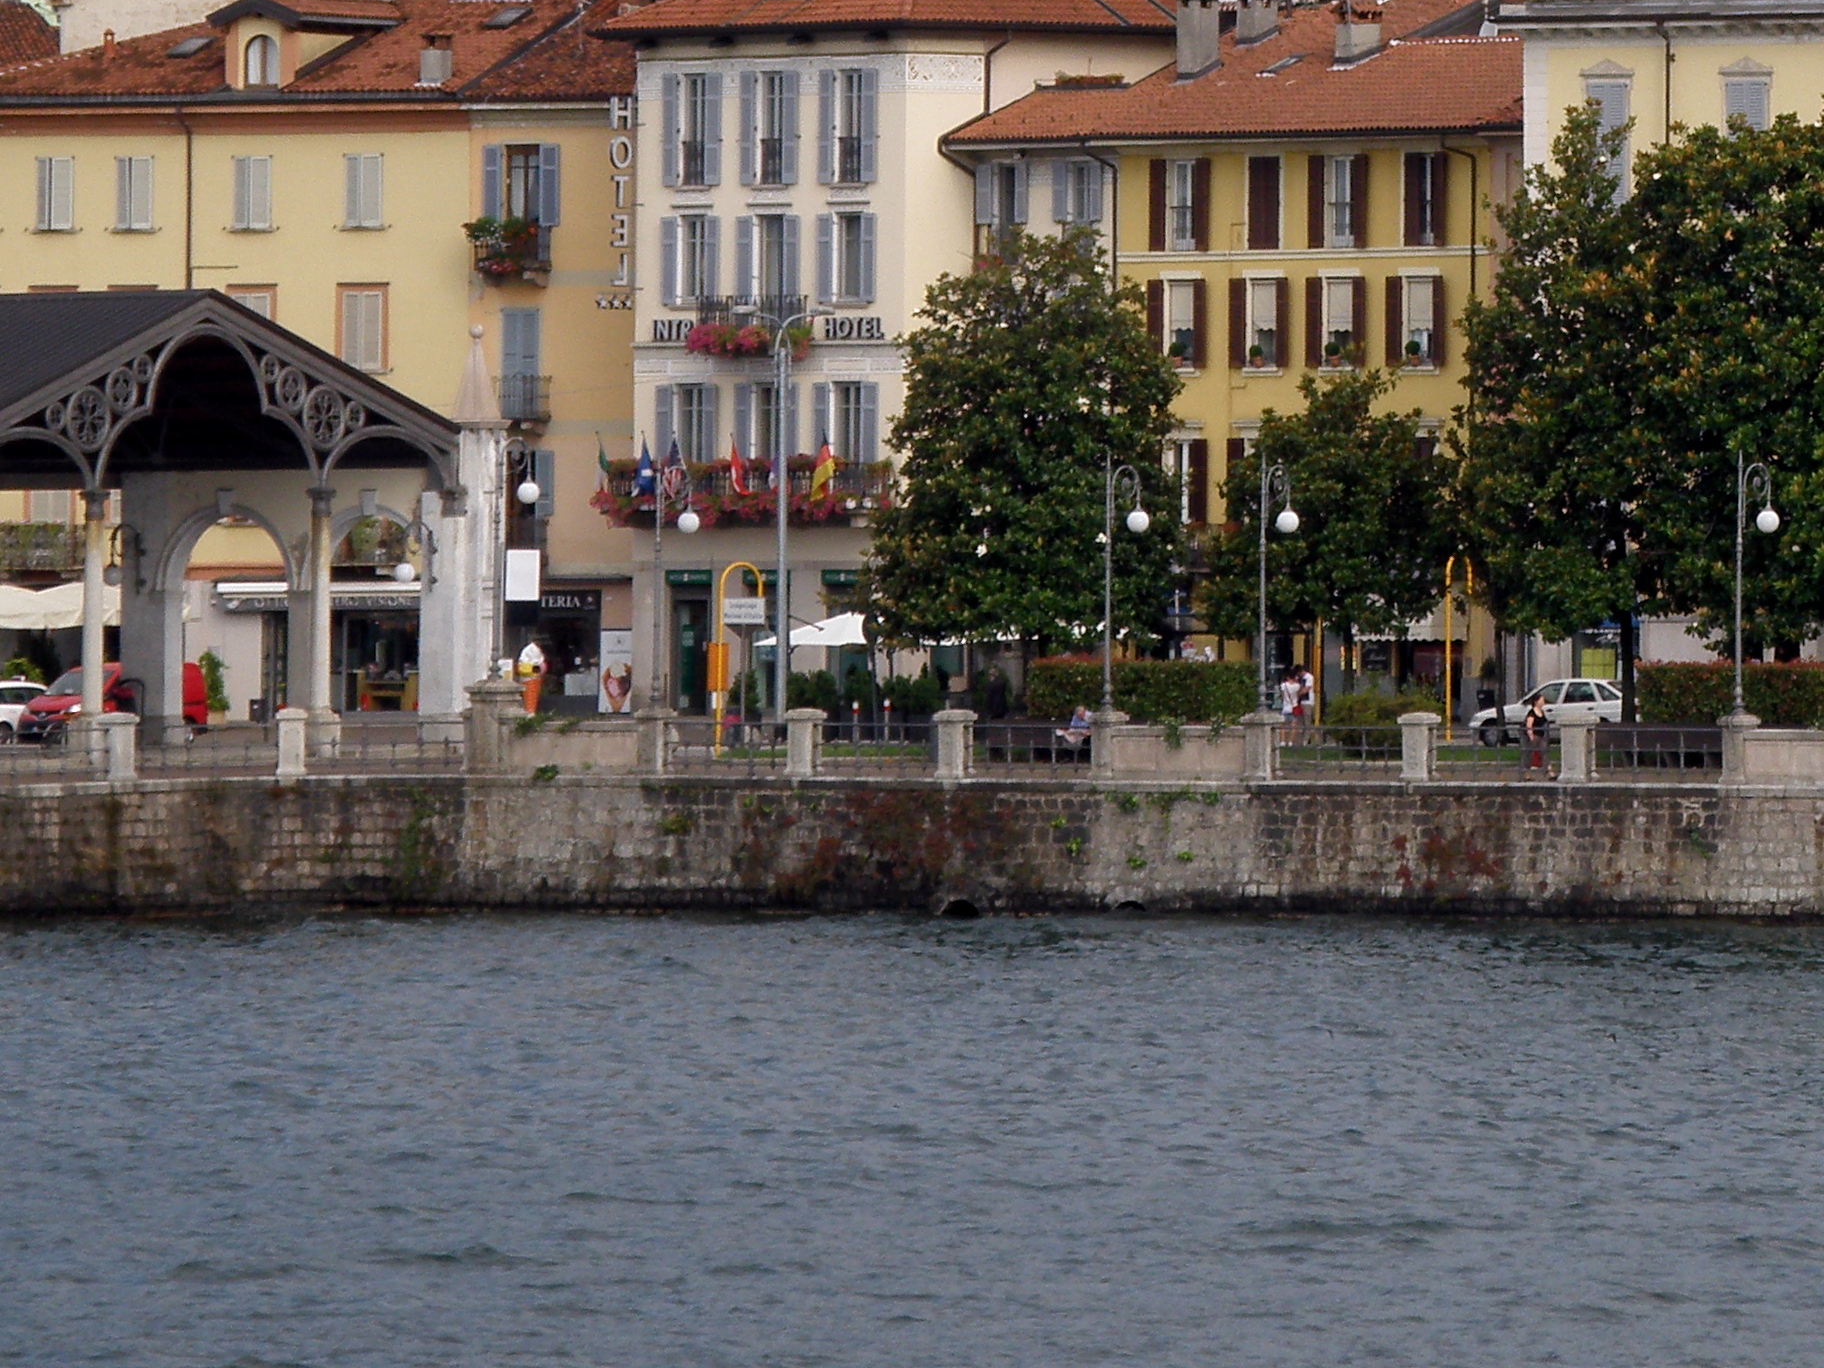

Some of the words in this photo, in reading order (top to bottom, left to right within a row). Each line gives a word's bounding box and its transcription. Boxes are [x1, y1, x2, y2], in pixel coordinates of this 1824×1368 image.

[650, 318, 695, 341] INTR
[823, 317, 885, 339] HOTEL
[541, 595, 581, 608] TERIA
